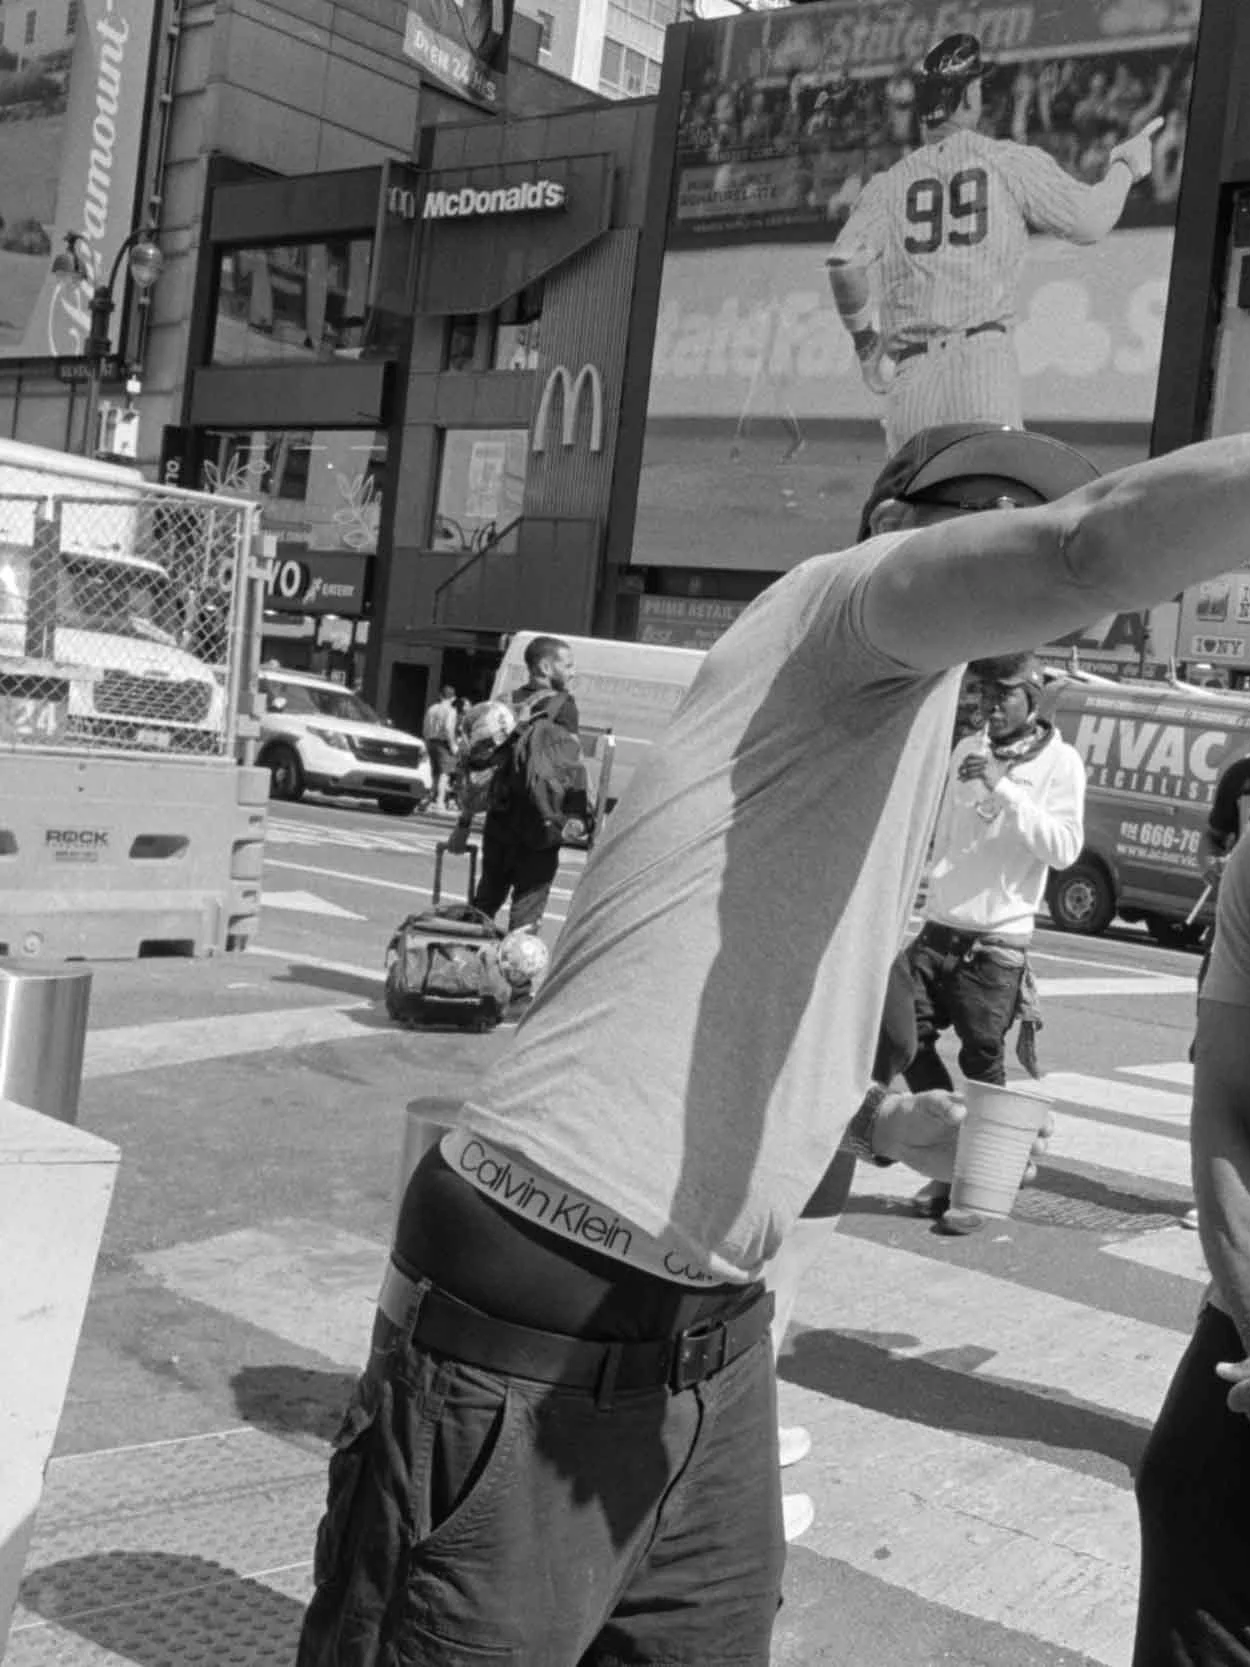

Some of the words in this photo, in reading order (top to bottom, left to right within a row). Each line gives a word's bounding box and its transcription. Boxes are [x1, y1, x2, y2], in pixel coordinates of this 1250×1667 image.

[423, 180, 566, 219] McDonald's
[904, 167, 989, 254] 99
[1075, 713, 1228, 782] HVAC
[45, 829, 109, 845] ROCK
[458, 1139, 551, 1218] Calvin
[550, 1194, 633, 1256] Klein
